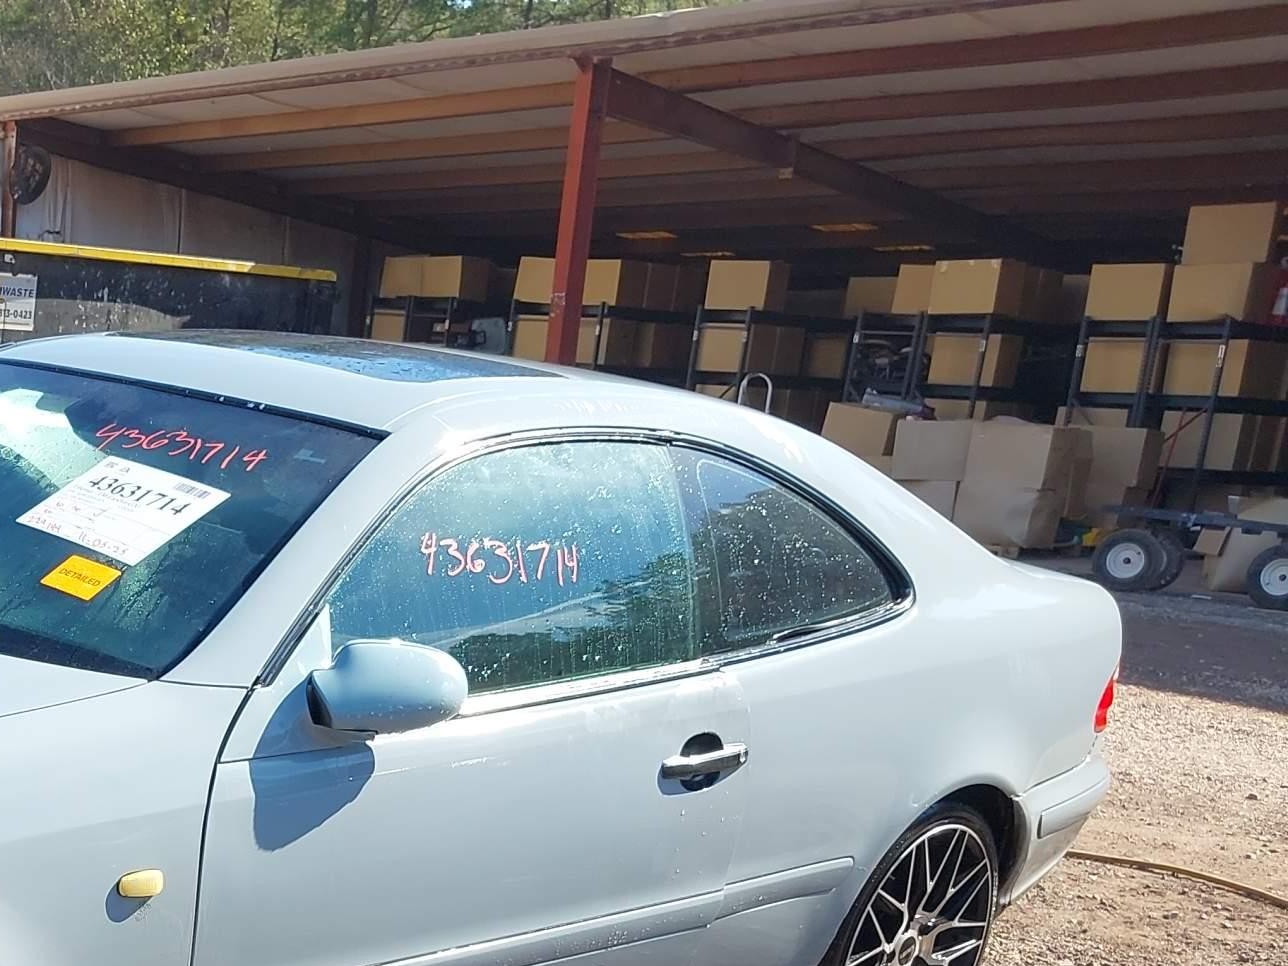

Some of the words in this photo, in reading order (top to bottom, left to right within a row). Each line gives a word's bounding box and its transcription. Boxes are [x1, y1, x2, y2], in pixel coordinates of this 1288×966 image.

[95, 423, 268, 471] 43631714
[88, 475, 192, 516] 43631714
[58, 567, 101, 588] DETAILED
[420, 532, 578, 587] 43631714
